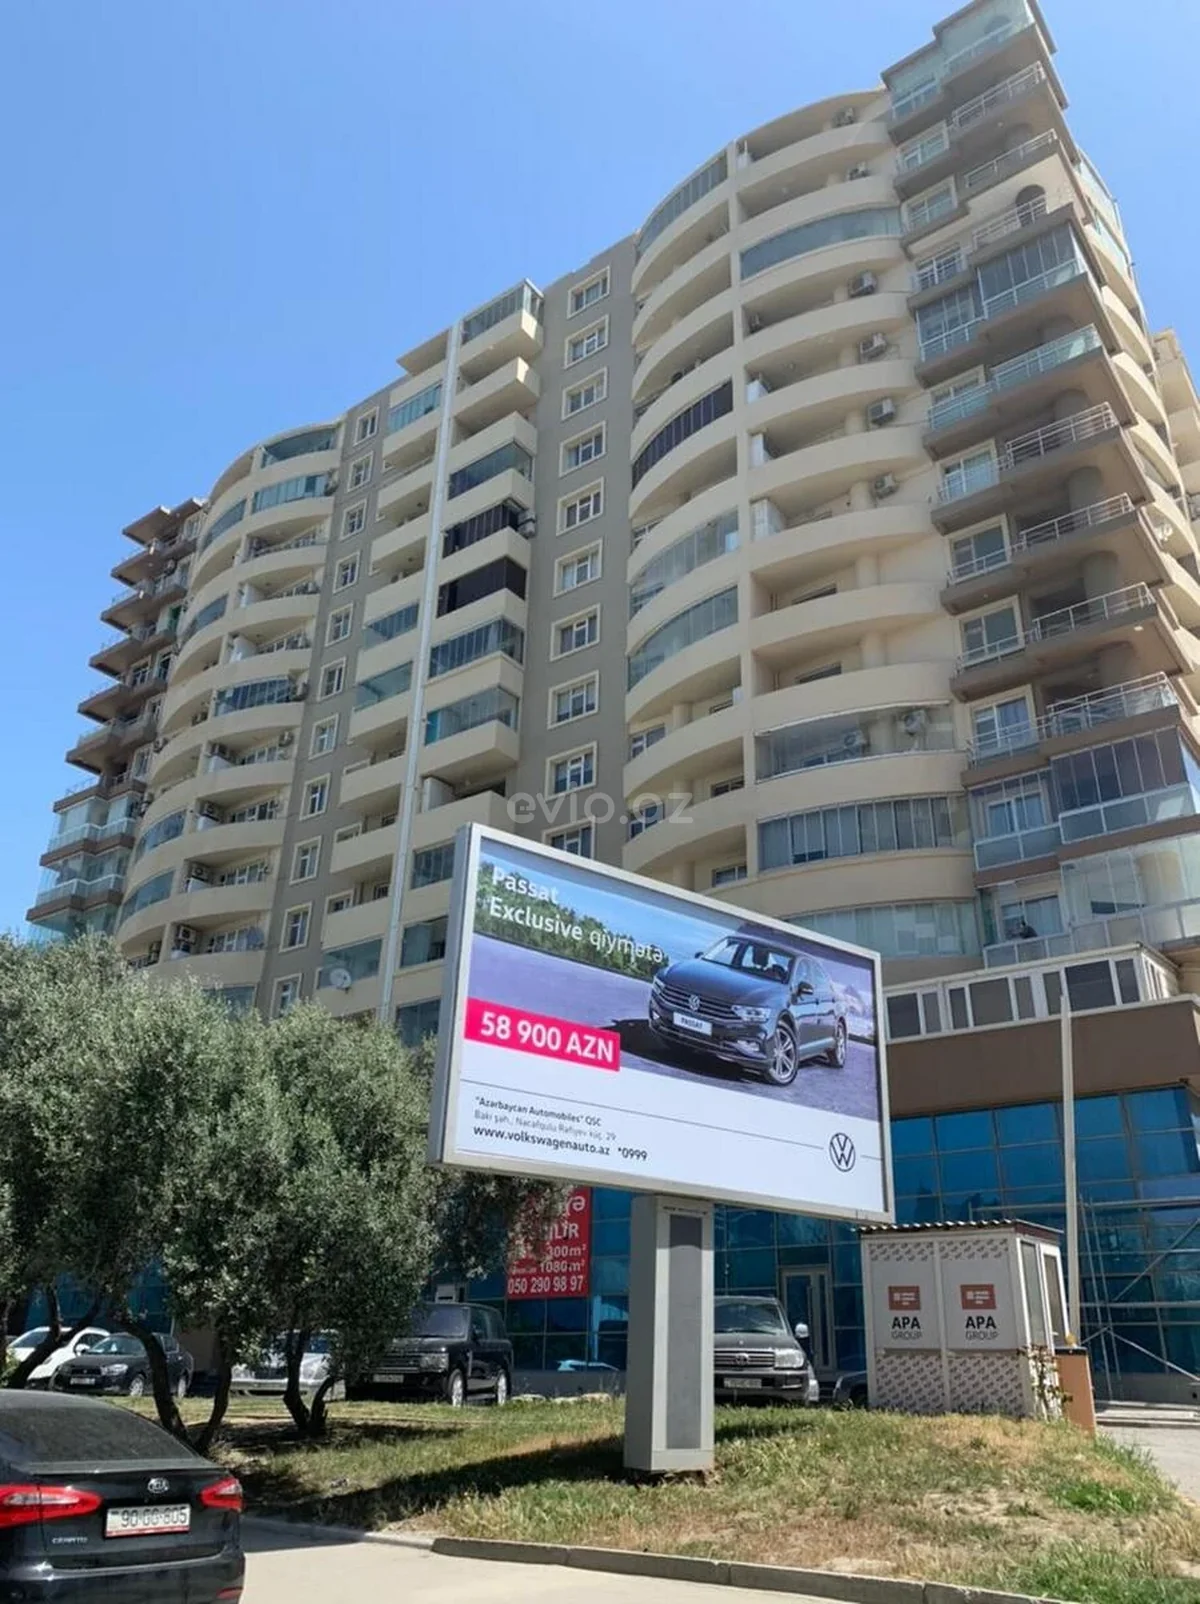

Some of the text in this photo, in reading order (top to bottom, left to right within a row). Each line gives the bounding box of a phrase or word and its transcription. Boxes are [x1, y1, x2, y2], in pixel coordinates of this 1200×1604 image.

[492, 866, 559, 904] Passat
[489, 896, 584, 941] Exclusive
[480, 1010, 614, 1063] 58 900 AZN
[473, 1126, 611, 1156] www.volkswagenauto.az
[507, 1278, 528, 1294] 050
[569, 1274, 584, 1291] 97
[891, 1316, 921, 1330] APA
[965, 1315, 997, 1330] APA
[891, 1330, 922, 1341] GROUP
[965, 1330, 999, 1341] GROUP
